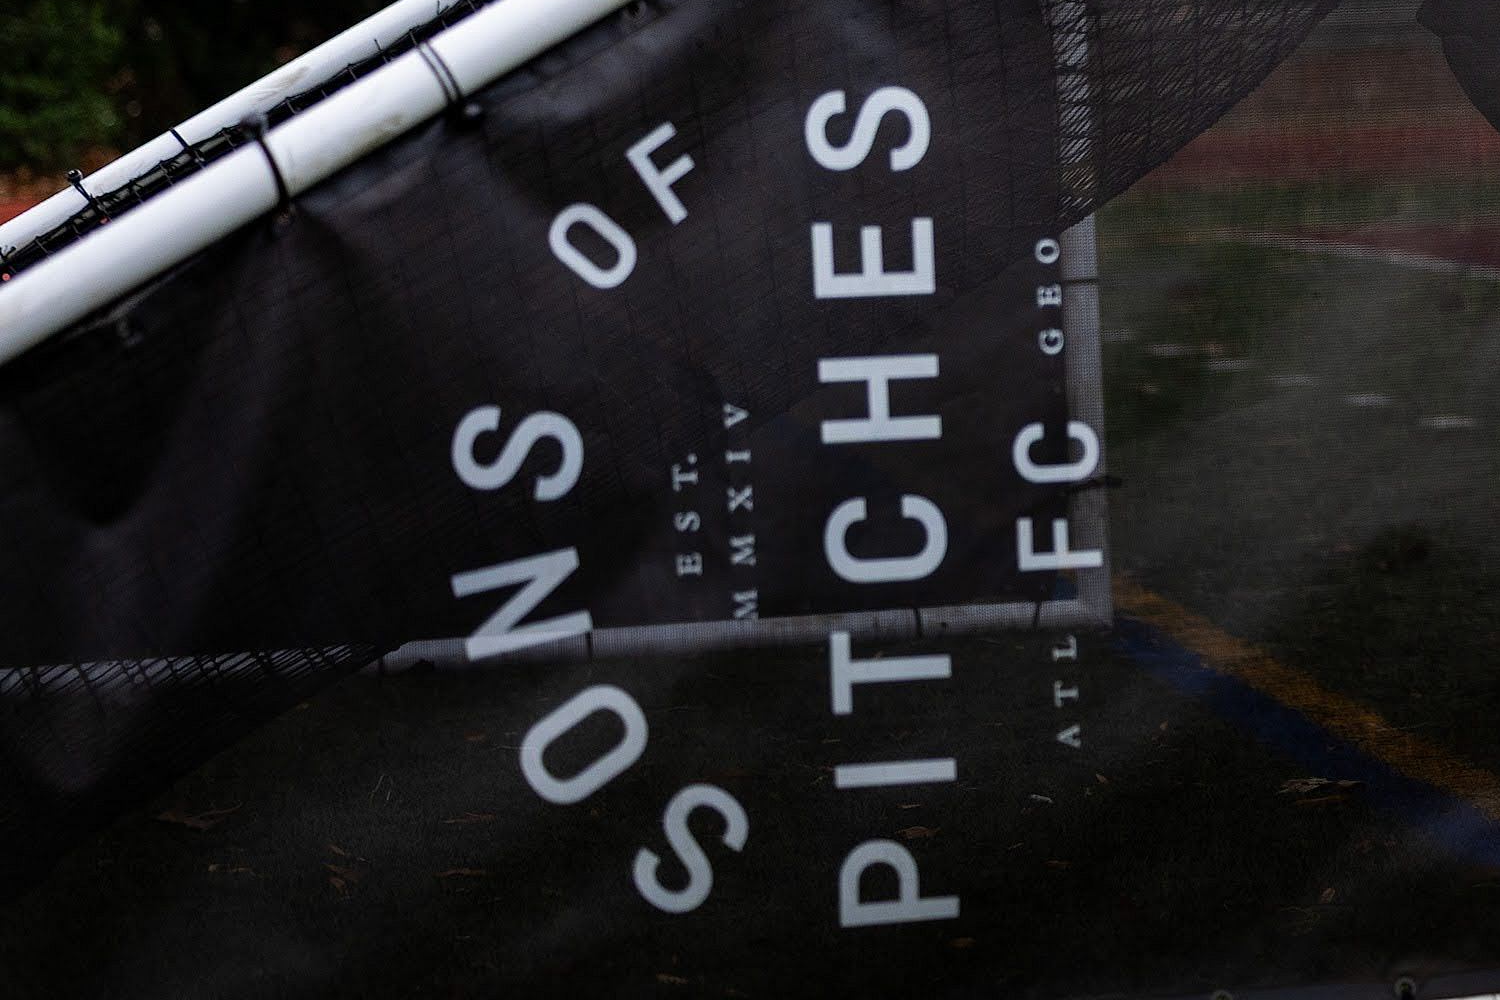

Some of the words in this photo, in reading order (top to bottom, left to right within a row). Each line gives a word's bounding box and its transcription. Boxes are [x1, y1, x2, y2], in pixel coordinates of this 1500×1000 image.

[548, 122, 695, 289] OF
[1034, 238, 1064, 355] GEO
[671, 453, 702, 576] EST.
[723, 402, 758, 620] MMXIV
[805, 86, 961, 928] PITCHES
[1013, 420, 1104, 572] FC
[451, 404, 749, 914] SONS
[1053, 634, 1081, 748] ATL
